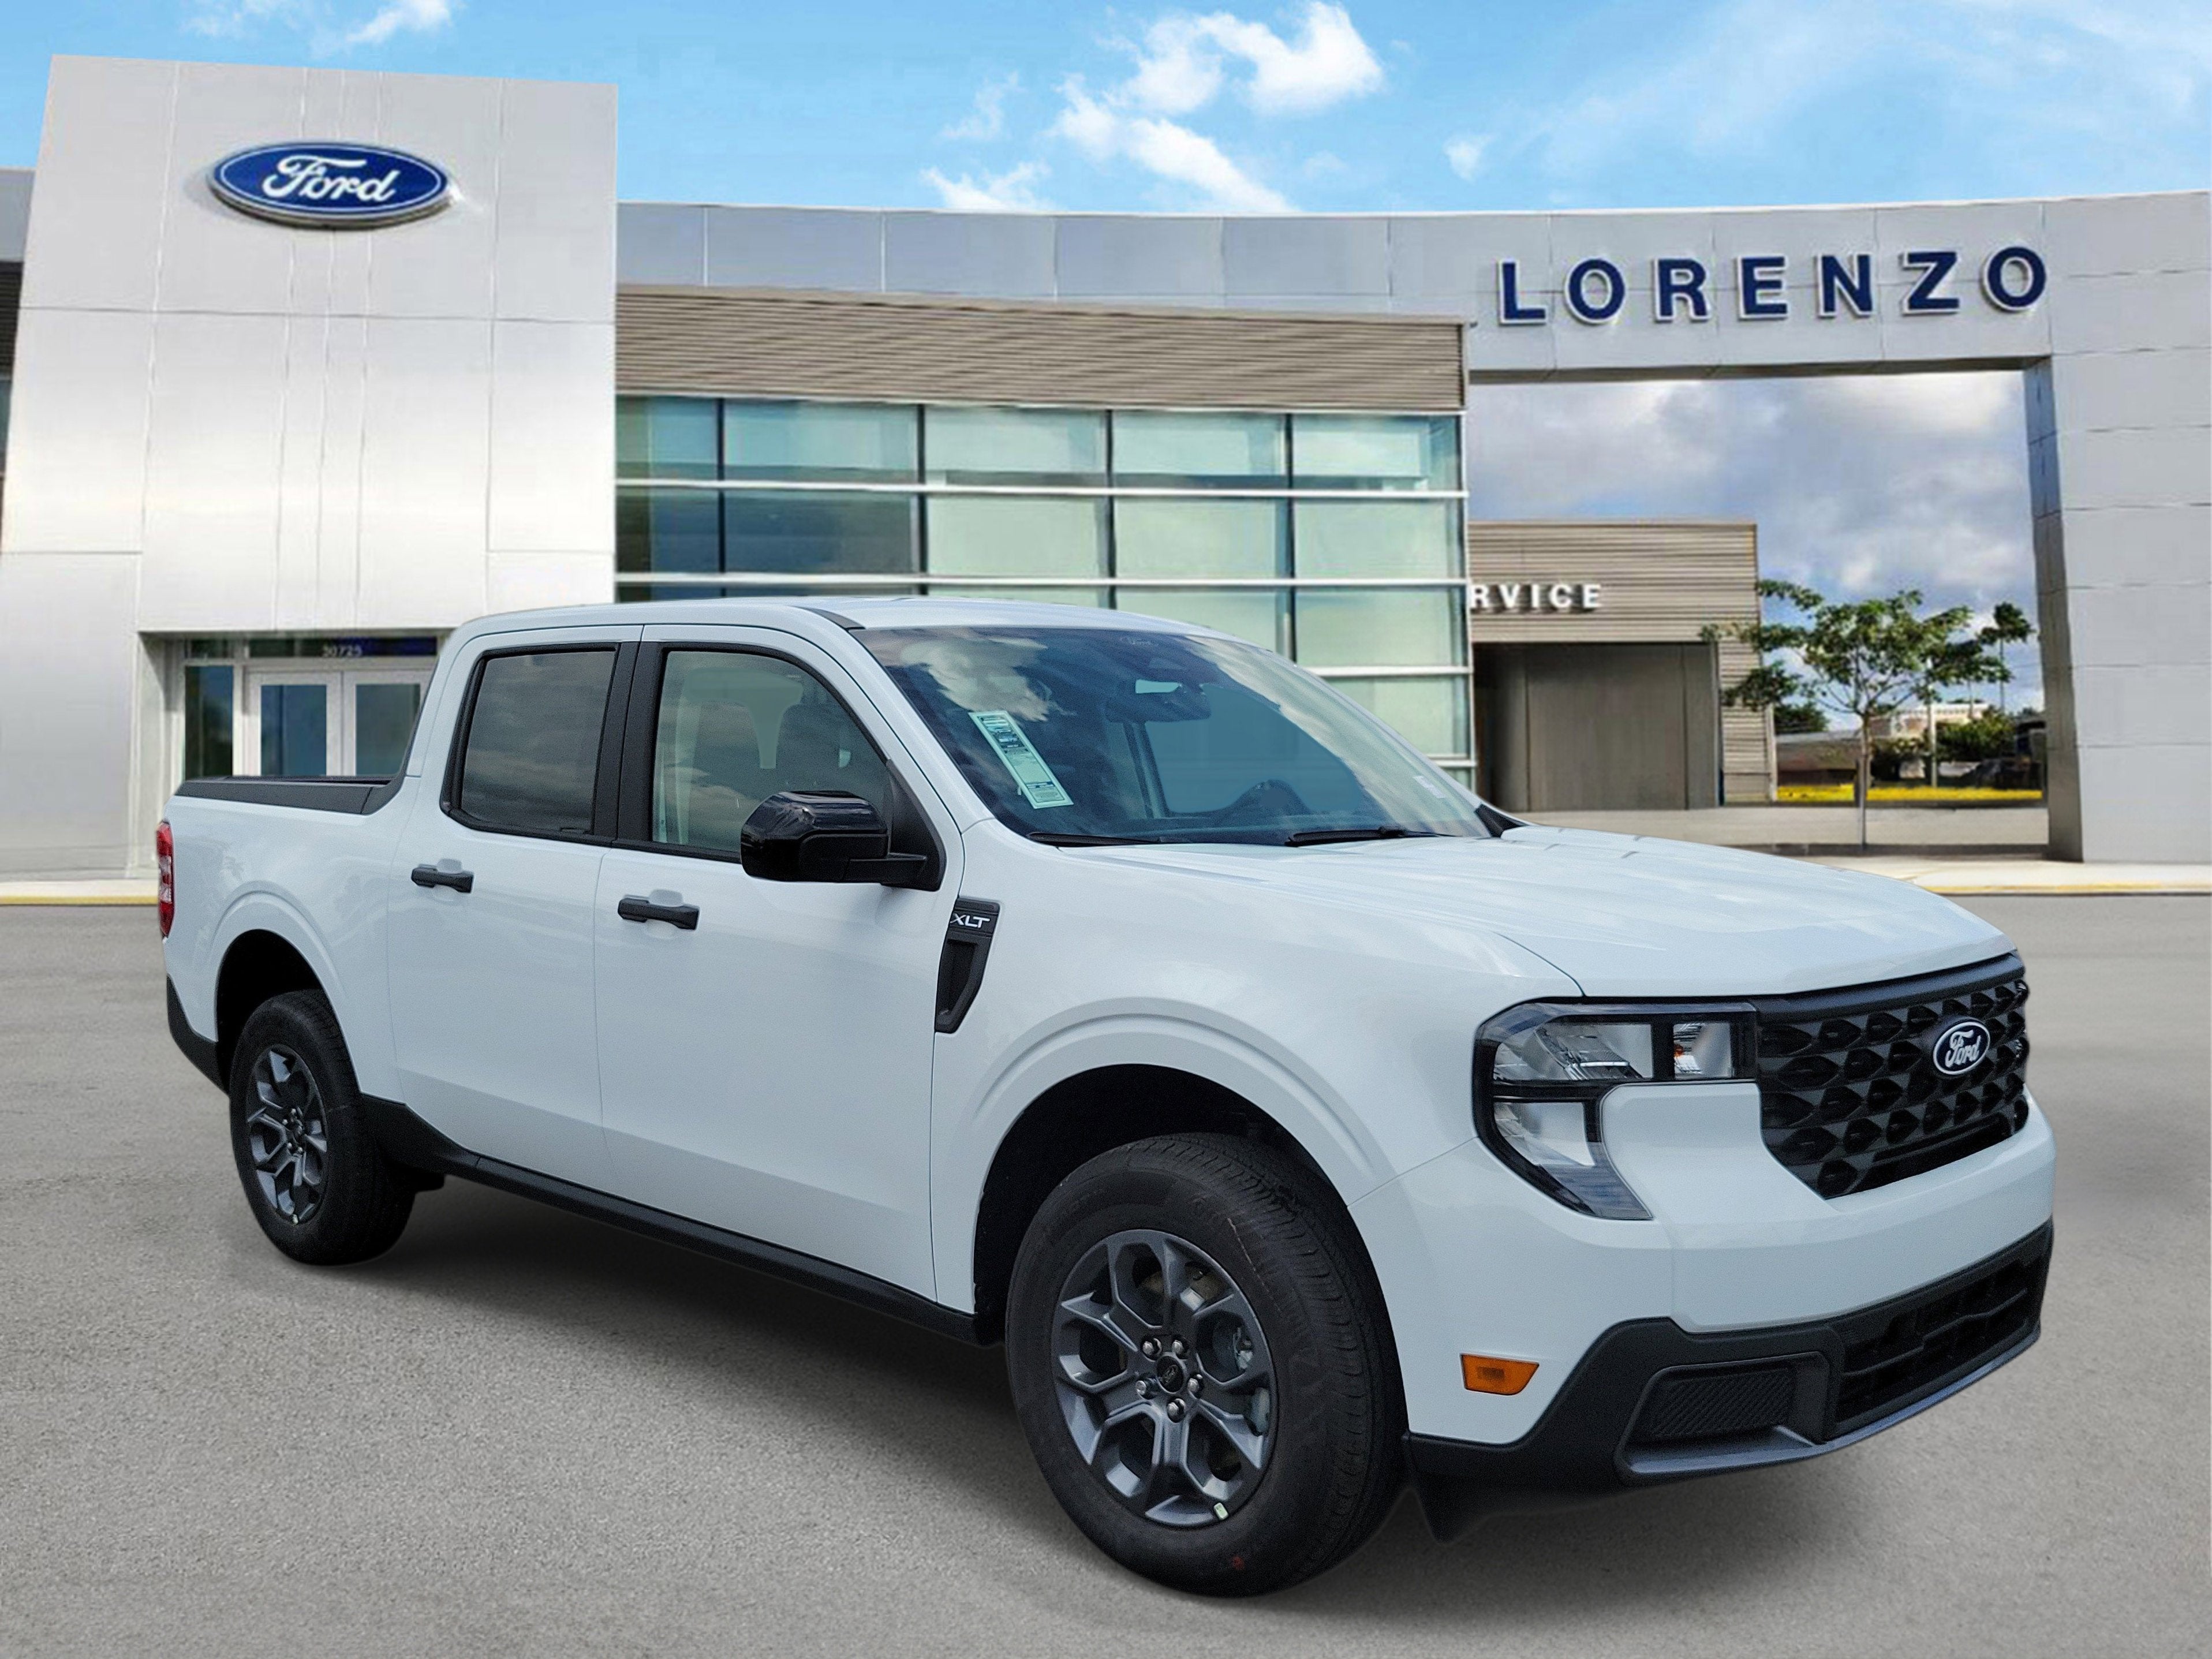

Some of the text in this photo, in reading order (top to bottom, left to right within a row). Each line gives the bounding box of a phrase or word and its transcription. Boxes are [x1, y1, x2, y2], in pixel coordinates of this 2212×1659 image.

[262, 154, 401, 201] Ford
[1500, 245, 2047, 326] LORENZO
[950, 913, 991, 928] XLT
[1945, 1029, 1981, 1068] Ford
